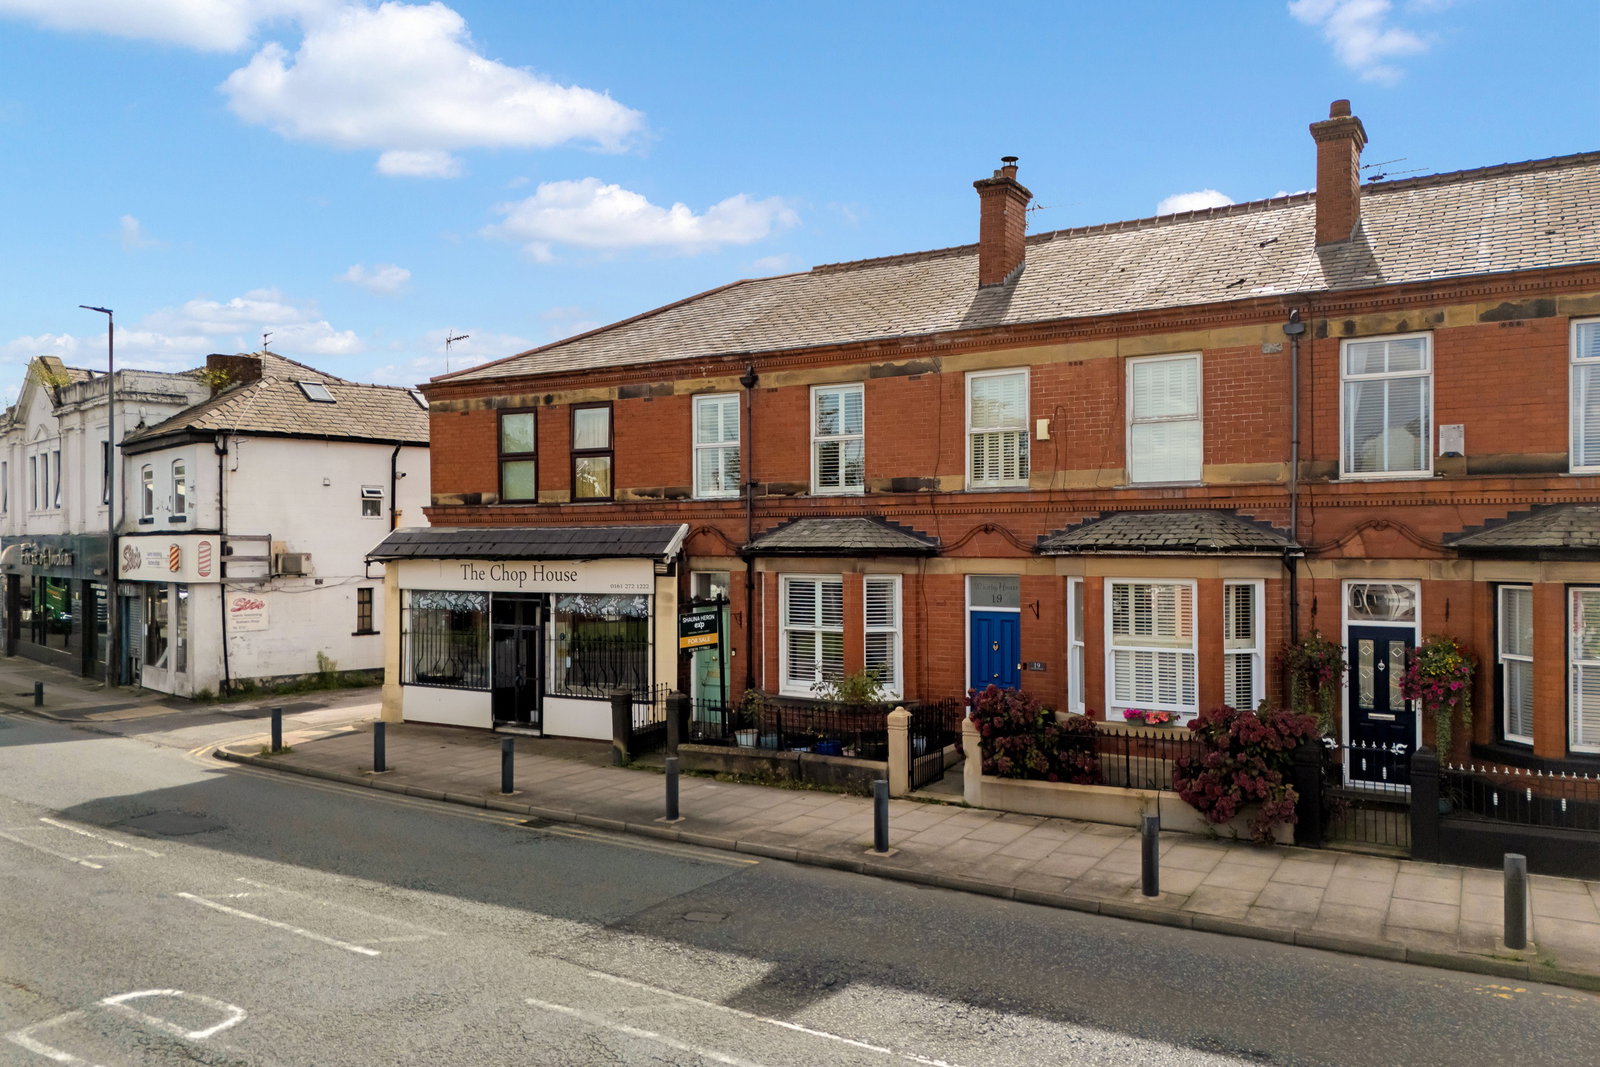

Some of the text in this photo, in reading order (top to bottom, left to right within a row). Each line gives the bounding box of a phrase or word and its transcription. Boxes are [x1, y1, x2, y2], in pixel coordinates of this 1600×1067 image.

[460, 563, 578, 588] The Chop House
[992, 594, 1002, 603] 19
[682, 616, 700, 624] SHAUNA
